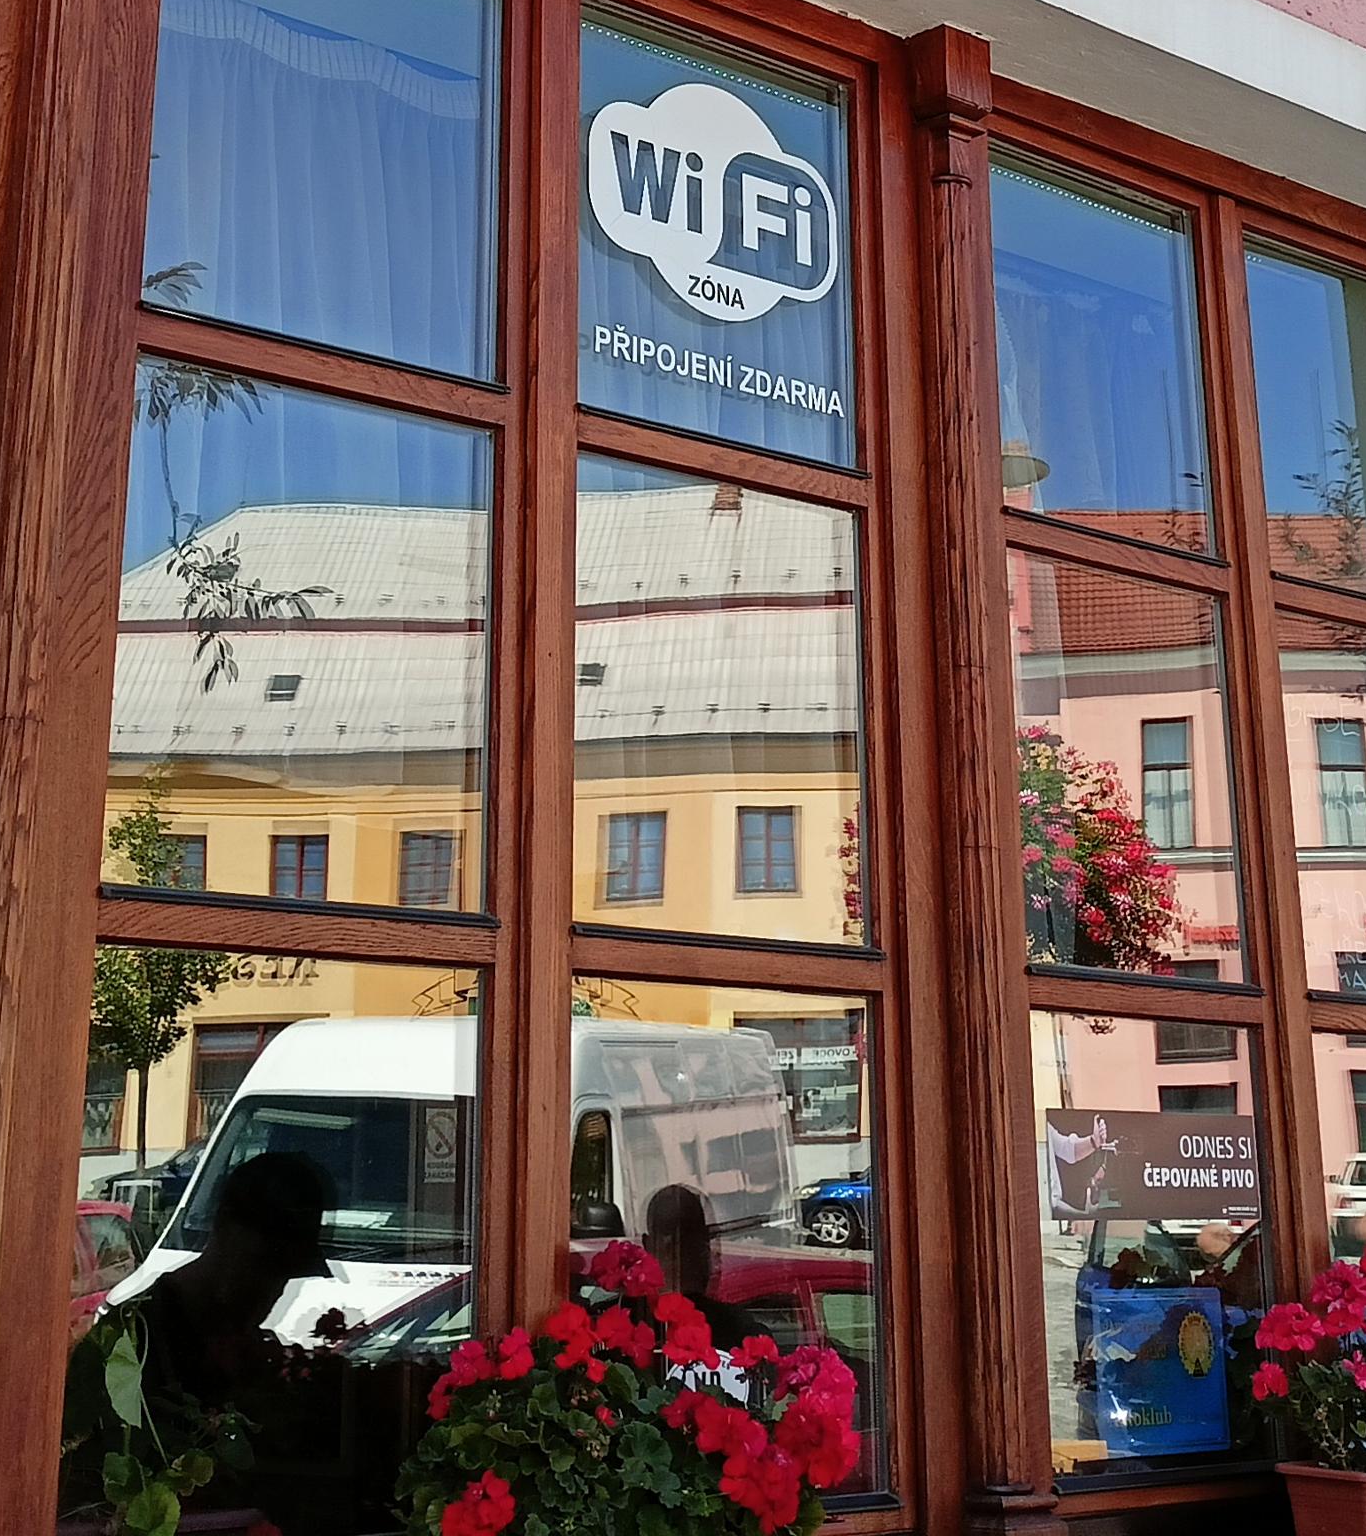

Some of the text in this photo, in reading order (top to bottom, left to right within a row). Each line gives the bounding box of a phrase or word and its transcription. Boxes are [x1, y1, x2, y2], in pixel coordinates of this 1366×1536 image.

[687, 274, 745, 311] ZÓNA
[594, 324, 846, 419] PŘIPOJENÍ ZDARMA
[1179, 1134, 1253, 1160] ODNES SI
[1143, 1162, 1255, 1189] ČEPOVANÉ PIVO
